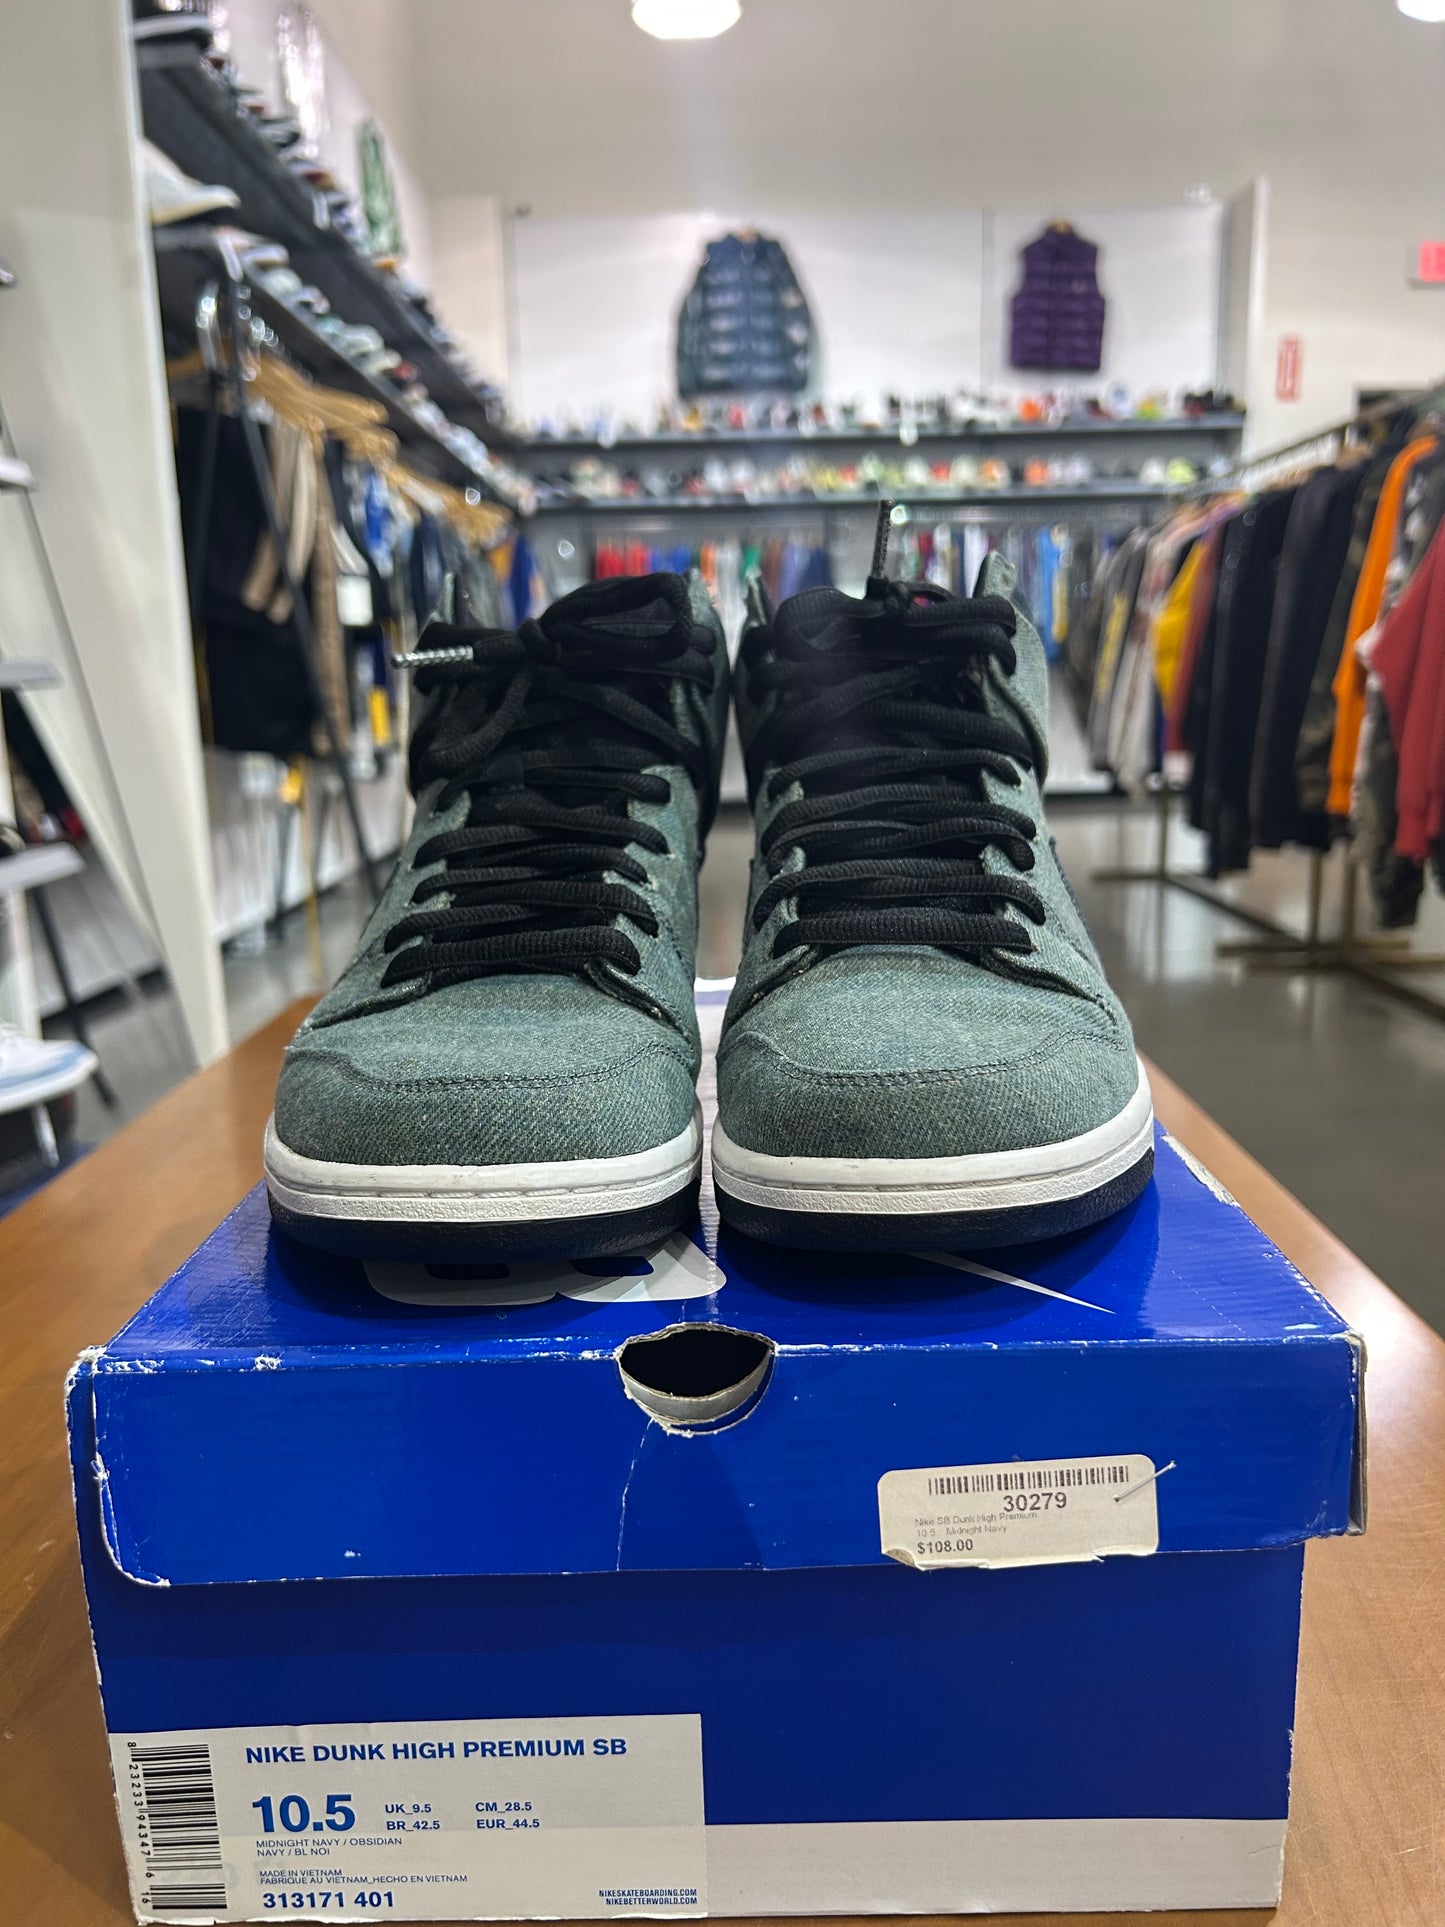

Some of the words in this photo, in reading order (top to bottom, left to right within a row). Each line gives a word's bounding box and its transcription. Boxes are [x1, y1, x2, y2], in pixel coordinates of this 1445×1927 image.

[1003, 1492, 1067, 1512] 30279
[914, 1517, 935, 1527] Nike
[937, 1516, 950, 1525] SB
[952, 1514, 975, 1525] Dunk
[976, 1513, 997, 1524] High
[999, 1511, 1038, 1521] Premium
[917, 1528, 936, 1538] 105
[946, 1525, 983, 1537] Midnight
[986, 1524, 1008, 1535] Navy
[917, 1538, 974, 1555] $108.00
[246, 1747, 306, 1763] NIKE
[313, 1744, 385, 1761] DUNK
[393, 1742, 455, 1760] HIGH
[463, 1740, 585, 1757] PREMIUM
[593, 1738, 627, 1755] SB
[252, 1794, 356, 1832] 10.5
[385, 1803, 432, 1815] UK_9.5
[475, 1801, 532, 1814] CM_28.5
[386, 1819, 440, 1831] BR_42.5
[476, 1818, 540, 1830] EUR_44.5
[256, 1839, 309, 1848] MIDNIGHT
[312, 1838, 340, 1847] NAVY
[350, 1837, 402, 1846] OBSIDIAN
[257, 1848, 287, 1857] NAVY
[295, 1847, 308, 1856] BL
[311, 1847, 330, 1856] NOI
[300, 1868, 342, 1876] VIETNAM
[260, 1877, 307, 1885] FABRIQUE
[310, 1876, 323, 1884] AU
[326, 1875, 408, 1885] VIETNAM_HECHO
[411, 1875, 424, 1883] EN
[426, 1874, 468, 1883] VIETNAM
[599, 1888, 697, 1898] NIKESKATEBOARDING.COM
[263, 1891, 345, 1909] 313171
[354, 1890, 394, 1908] 401
[606, 1897, 698, 1906] NIKEBETTERWORLD.COM
